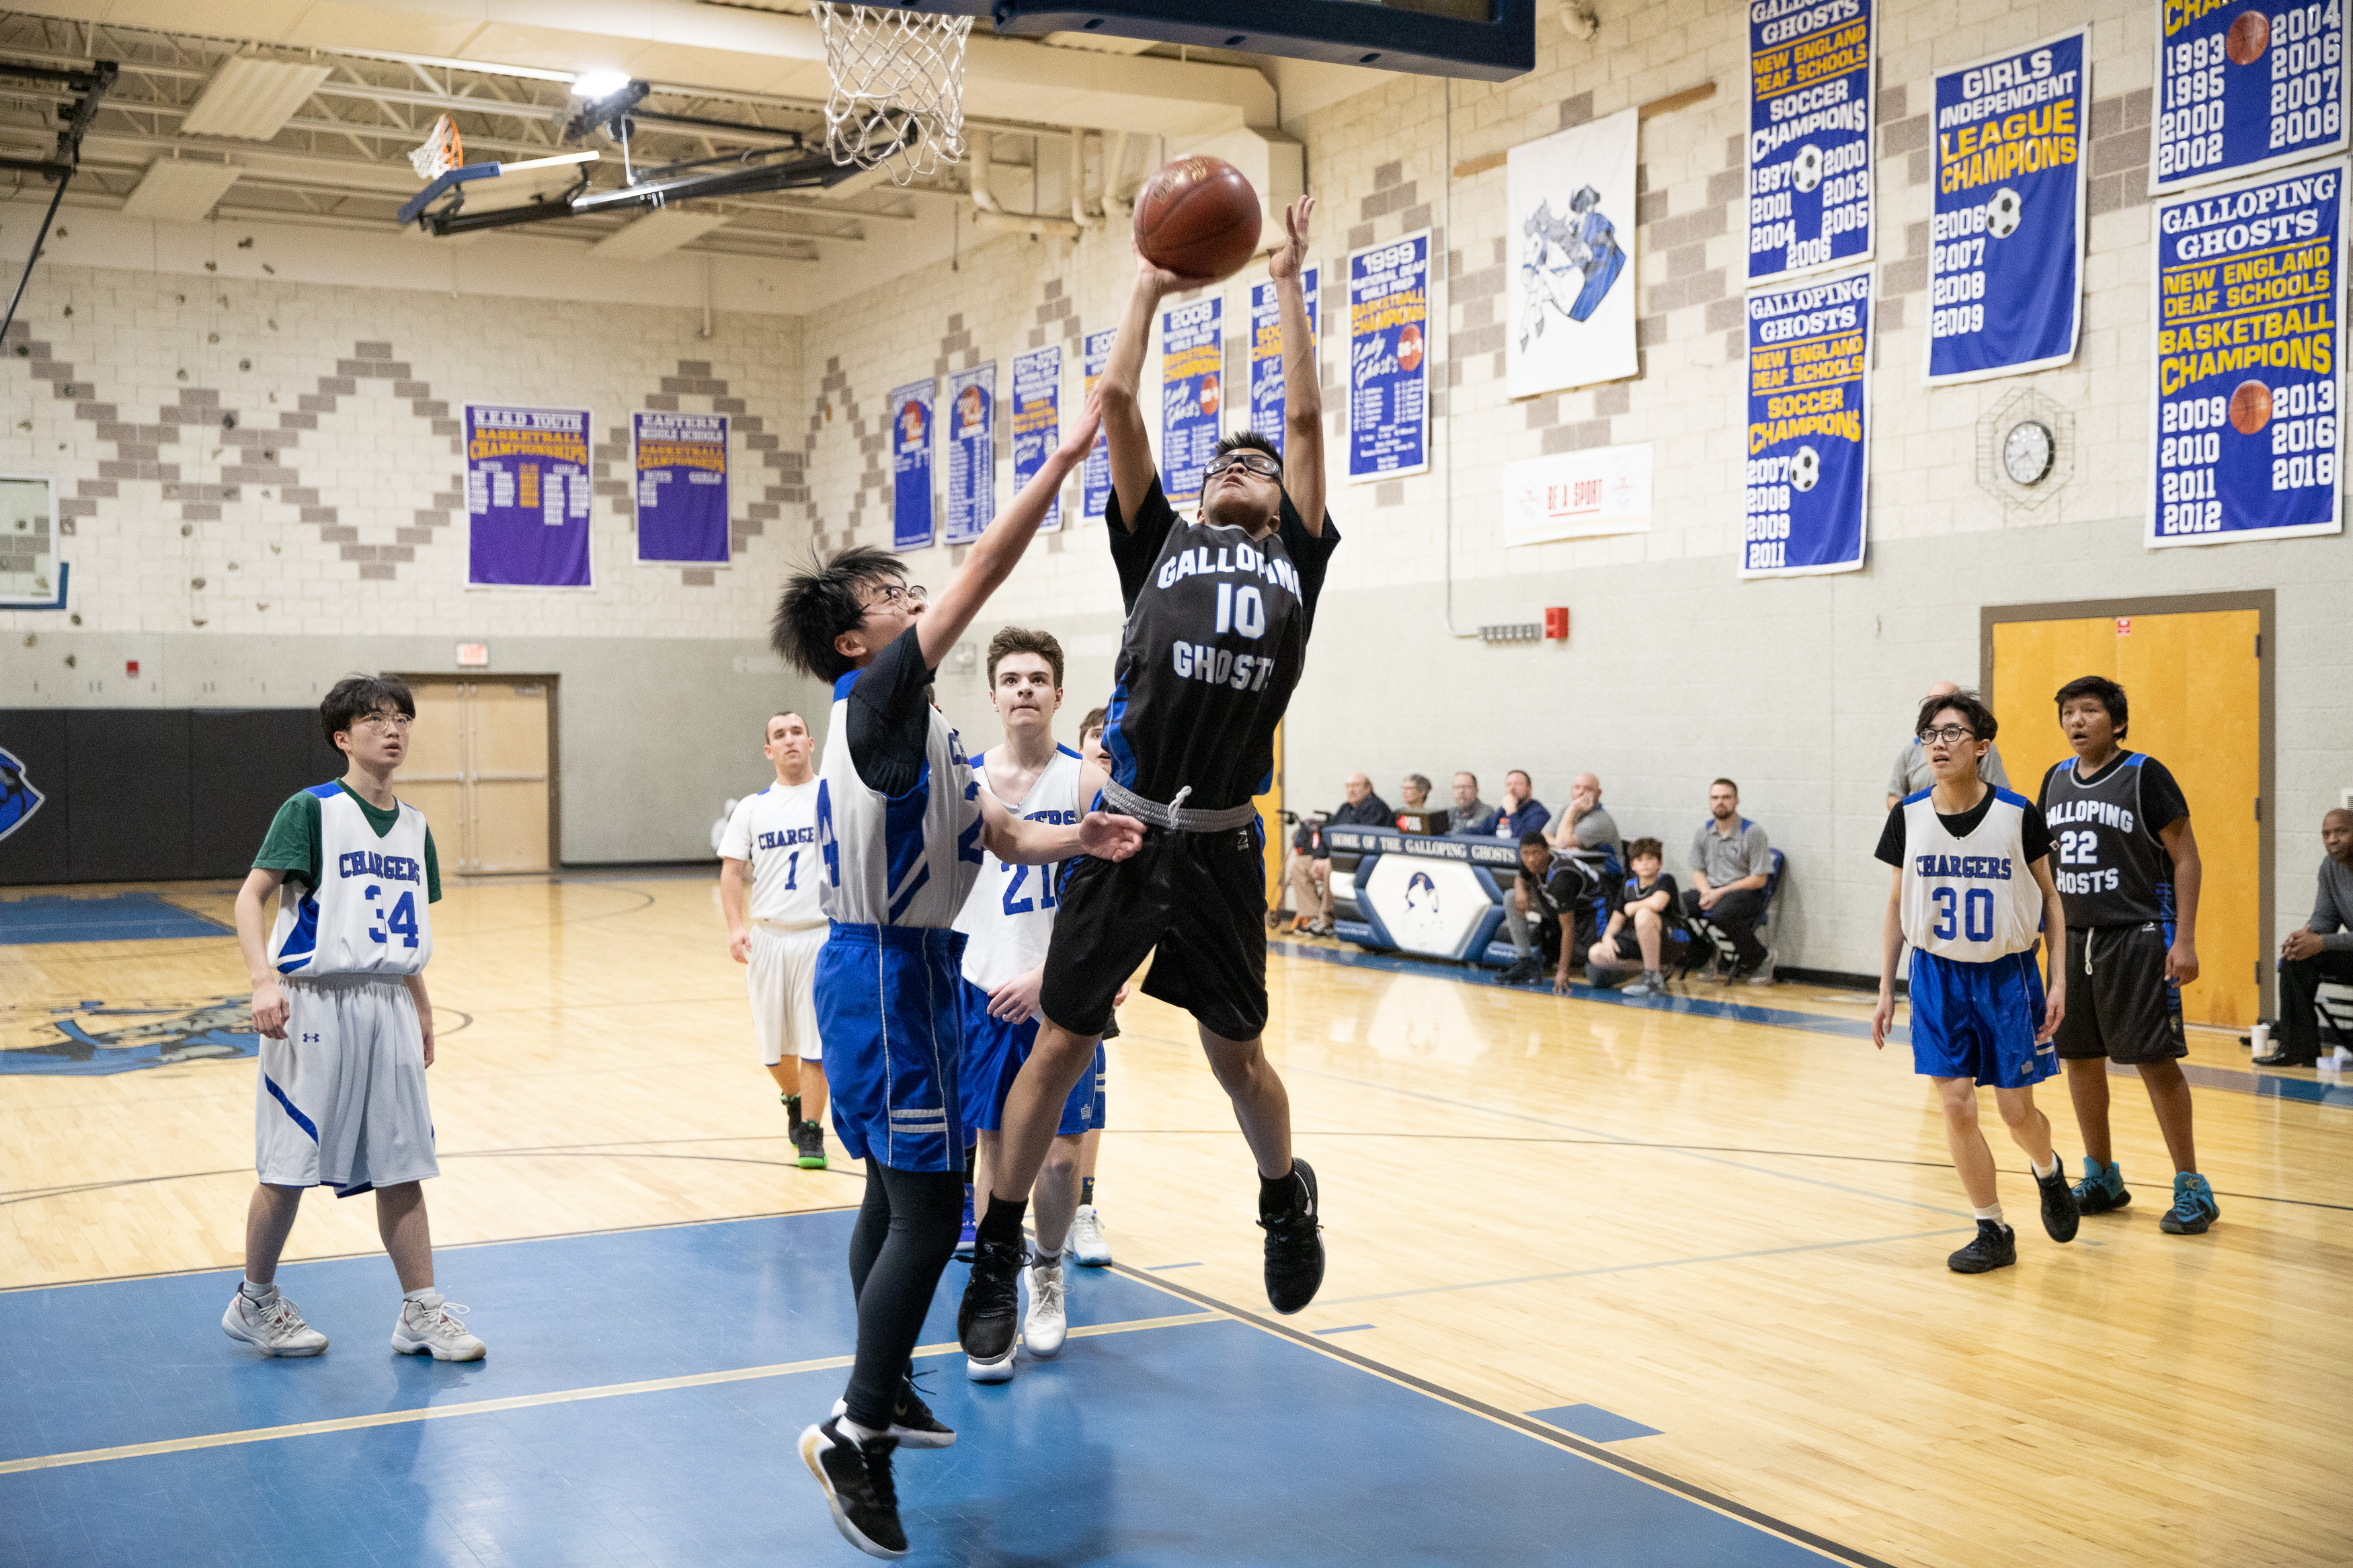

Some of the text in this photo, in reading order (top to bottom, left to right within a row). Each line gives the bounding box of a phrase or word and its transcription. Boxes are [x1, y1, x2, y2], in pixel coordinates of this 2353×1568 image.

[1761, 0, 1860, 46] GHOSTS
[2271, 0, 2342, 48] 2004
[1753, 24, 1866, 76] NEW ENGLAND
[1796, 42, 1867, 82] SCHOOLS
[2166, 32, 2225, 77] 1993
[2271, 32, 2341, 81] 2006
[1962, 49, 2053, 100] GIRLS
[2166, 66, 2225, 110] 1995
[2270, 65, 2340, 116] 2007
[1769, 78, 1849, 122] SOCCER
[1940, 71, 2077, 129] INDEPENDENT
[1751, 98, 1866, 163] CHAMPIONS
[1940, 99, 2075, 166] LEAGUE
[2159, 99, 2225, 144] 2000
[2269, 101, 2340, 150] 2008
[1823, 140, 1866, 175] 2000
[1941, 136, 2078, 195] CHAMPIONS
[2159, 132, 2223, 176] 2002
[1751, 161, 1792, 195] 1997
[1822, 174, 1868, 207] 2003
[1751, 192, 1792, 224] 2001
[1821, 206, 1869, 237] 2005
[1934, 204, 1986, 241] 2006
[2161, 173, 2337, 235] GALLOPING
[1751, 220, 1797, 254] 2004
[1786, 237, 1832, 270] 2006
[2176, 208, 2319, 261] GHOSTS
[1361, 241, 1417, 276] 1999
[1934, 237, 1985, 274] 2007
[2162, 245, 2331, 296] NEW ENGLAND
[1351, 267, 1398, 292] NATIONAL
[1360, 276, 1417, 302] GIRLS PREP
[1933, 270, 1986, 306] 2008
[2164, 270, 2330, 319] DEAF SCHOOLS
[1170, 302, 1213, 330] 2008
[1351, 286, 1426, 321] BASKETBALL
[1749, 277, 1869, 321] GALLOPING
[1351, 304, 1427, 337] CHAMPIONS
[1759, 306, 1858, 343] GHOSTS
[1933, 303, 1984, 339] 2009
[2158, 303, 2336, 356] BASKETBALL
[1353, 333, 1387, 368] Lady
[1751, 335, 1864, 371] NEW ENGLAND
[2160, 333, 2332, 397] CHAMPIONS
[1752, 354, 1864, 390] DEAF SCHOOLS
[1767, 387, 1844, 420] SOCCER
[2161, 395, 2227, 434] 2009
[2272, 379, 2336, 420] 2013
[1749, 409, 1862, 456] CHAMPIONS
[2160, 432, 2221, 469] 2010
[2272, 415, 2336, 456] 2016
[1747, 455, 1791, 486] 2007
[2161, 467, 2217, 503] 2011
[2272, 452, 2335, 491] 2018
[1746, 485, 1791, 513] 2008
[2163, 499, 2223, 535] 2012
[1746, 513, 1791, 542] 2009
[1749, 541, 1786, 569] 2011
[1214, 582, 1265, 640] 10
[1172, 640, 1275, 692] GHOST
[758, 827, 814, 851] CHARGE
[1330, 831, 1517, 864] HOME OF THE GALLOPING GHOSTS
[2060, 830, 2098, 864] 22
[339, 850, 421, 886] CHARGERS
[784, 851, 799, 891] 1
[1916, 854, 2012, 880] CHARGERS
[2056, 867, 2119, 895] HOSTS
[1000, 862, 1055, 916] 21
[364, 884, 420, 948] 34
[1931, 886, 1995, 942] 30
